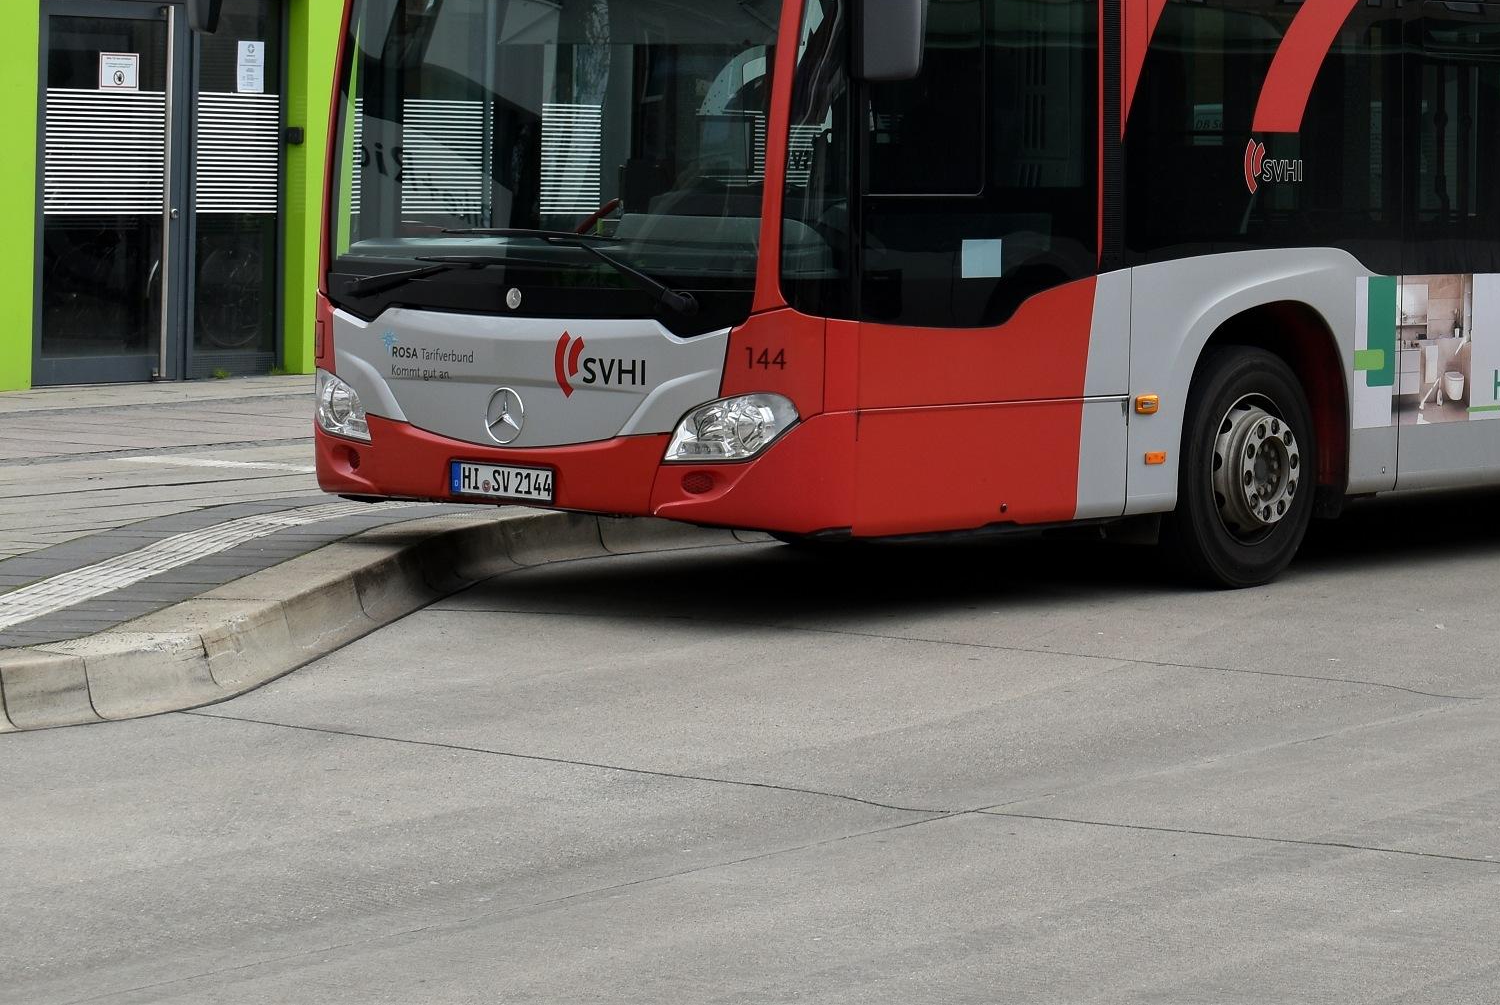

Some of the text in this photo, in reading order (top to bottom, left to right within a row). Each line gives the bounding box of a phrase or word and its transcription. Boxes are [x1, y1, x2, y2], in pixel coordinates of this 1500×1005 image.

[1262, 159, 1303, 182] SVHI
[392, 346, 474, 364] ROSA Tarifverbund
[745, 347, 787, 370] 144
[391, 364, 420, 378] Kommt
[423, 368, 436, 382] gut
[582, 358, 647, 386] SVHI
[462, 467, 480, 490] HI
[492, 469, 510, 492] SV
[515, 471, 552, 497] 2144
